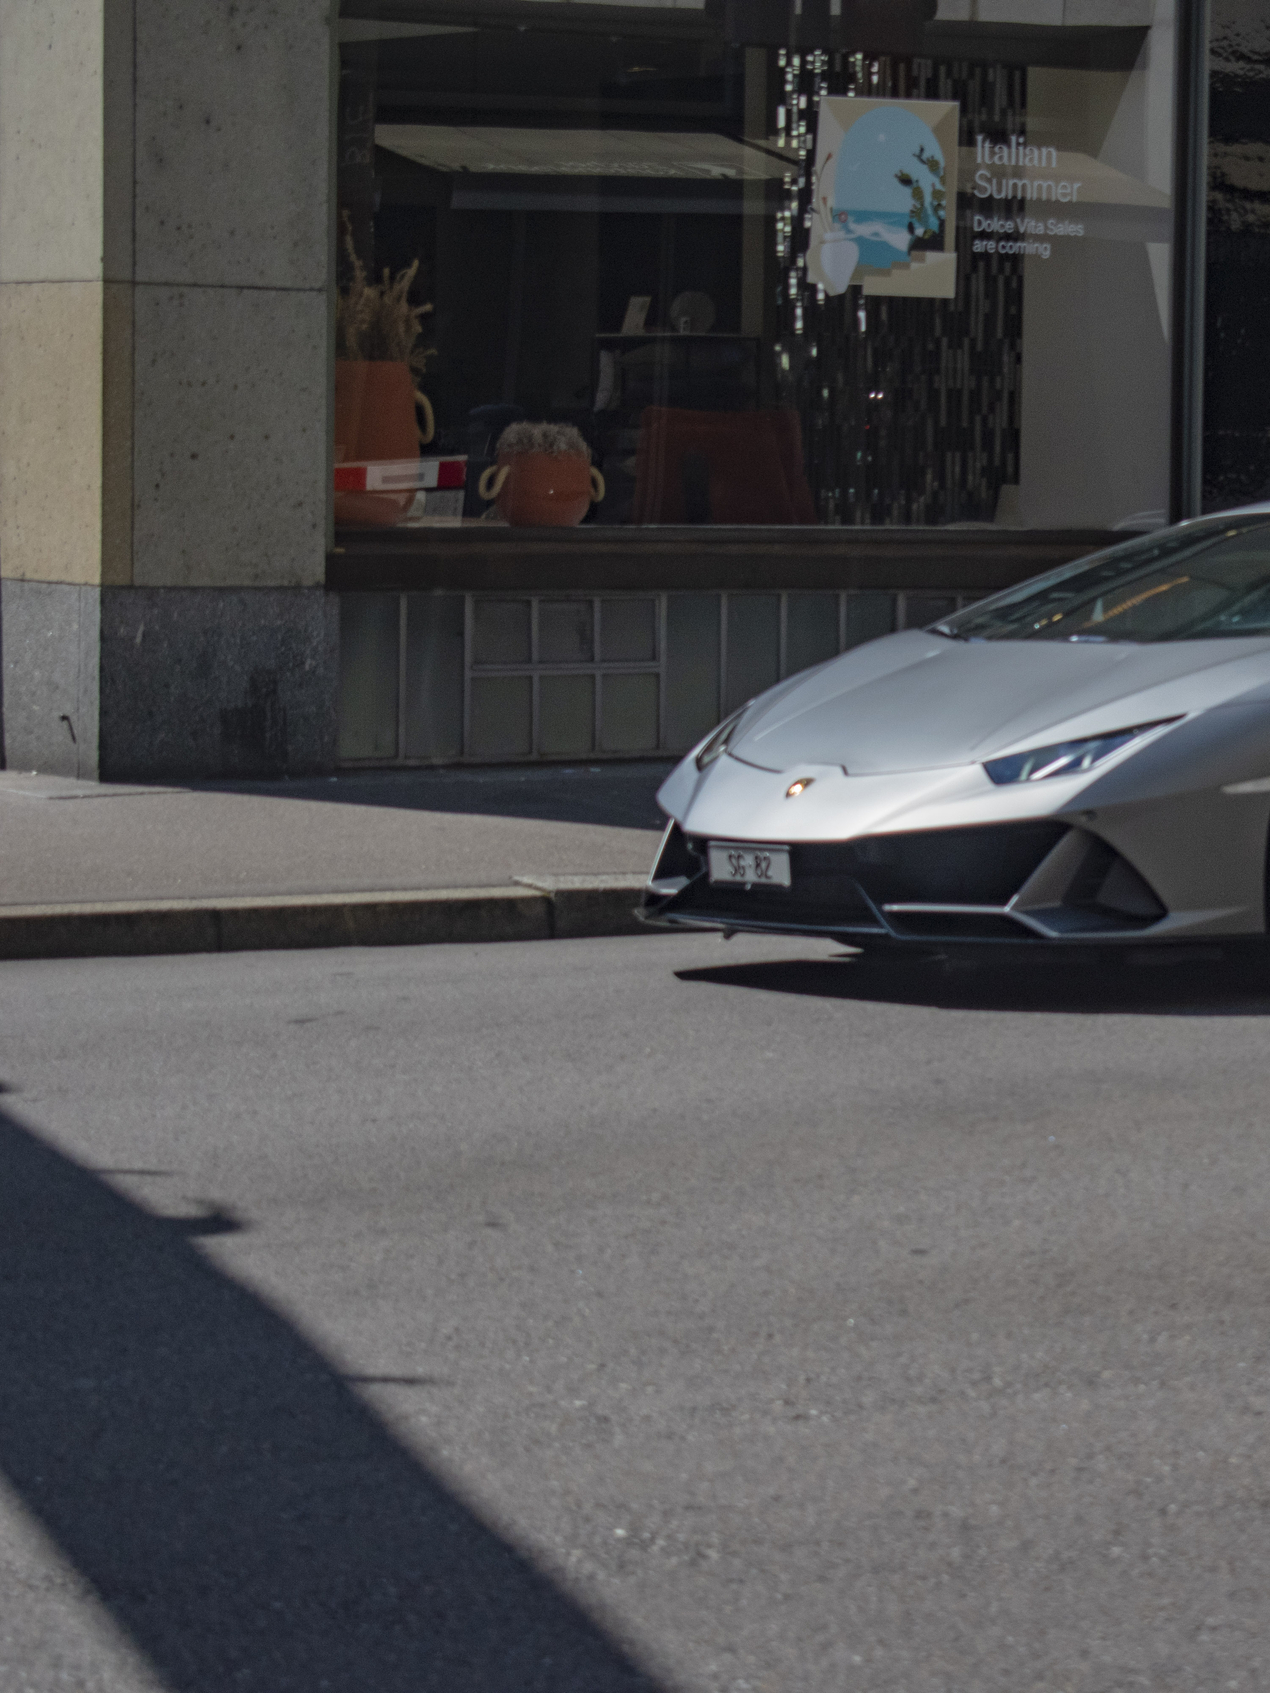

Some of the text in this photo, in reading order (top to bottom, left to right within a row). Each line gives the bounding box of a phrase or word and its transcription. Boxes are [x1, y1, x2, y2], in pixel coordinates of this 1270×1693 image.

[976, 134, 1057, 168] Italian
[974, 169, 1081, 203] Summer
[973, 214, 1085, 237] Dolce Vita Sales
[973, 240, 1051, 259] are coming
[728, 852, 746, 877] SG
